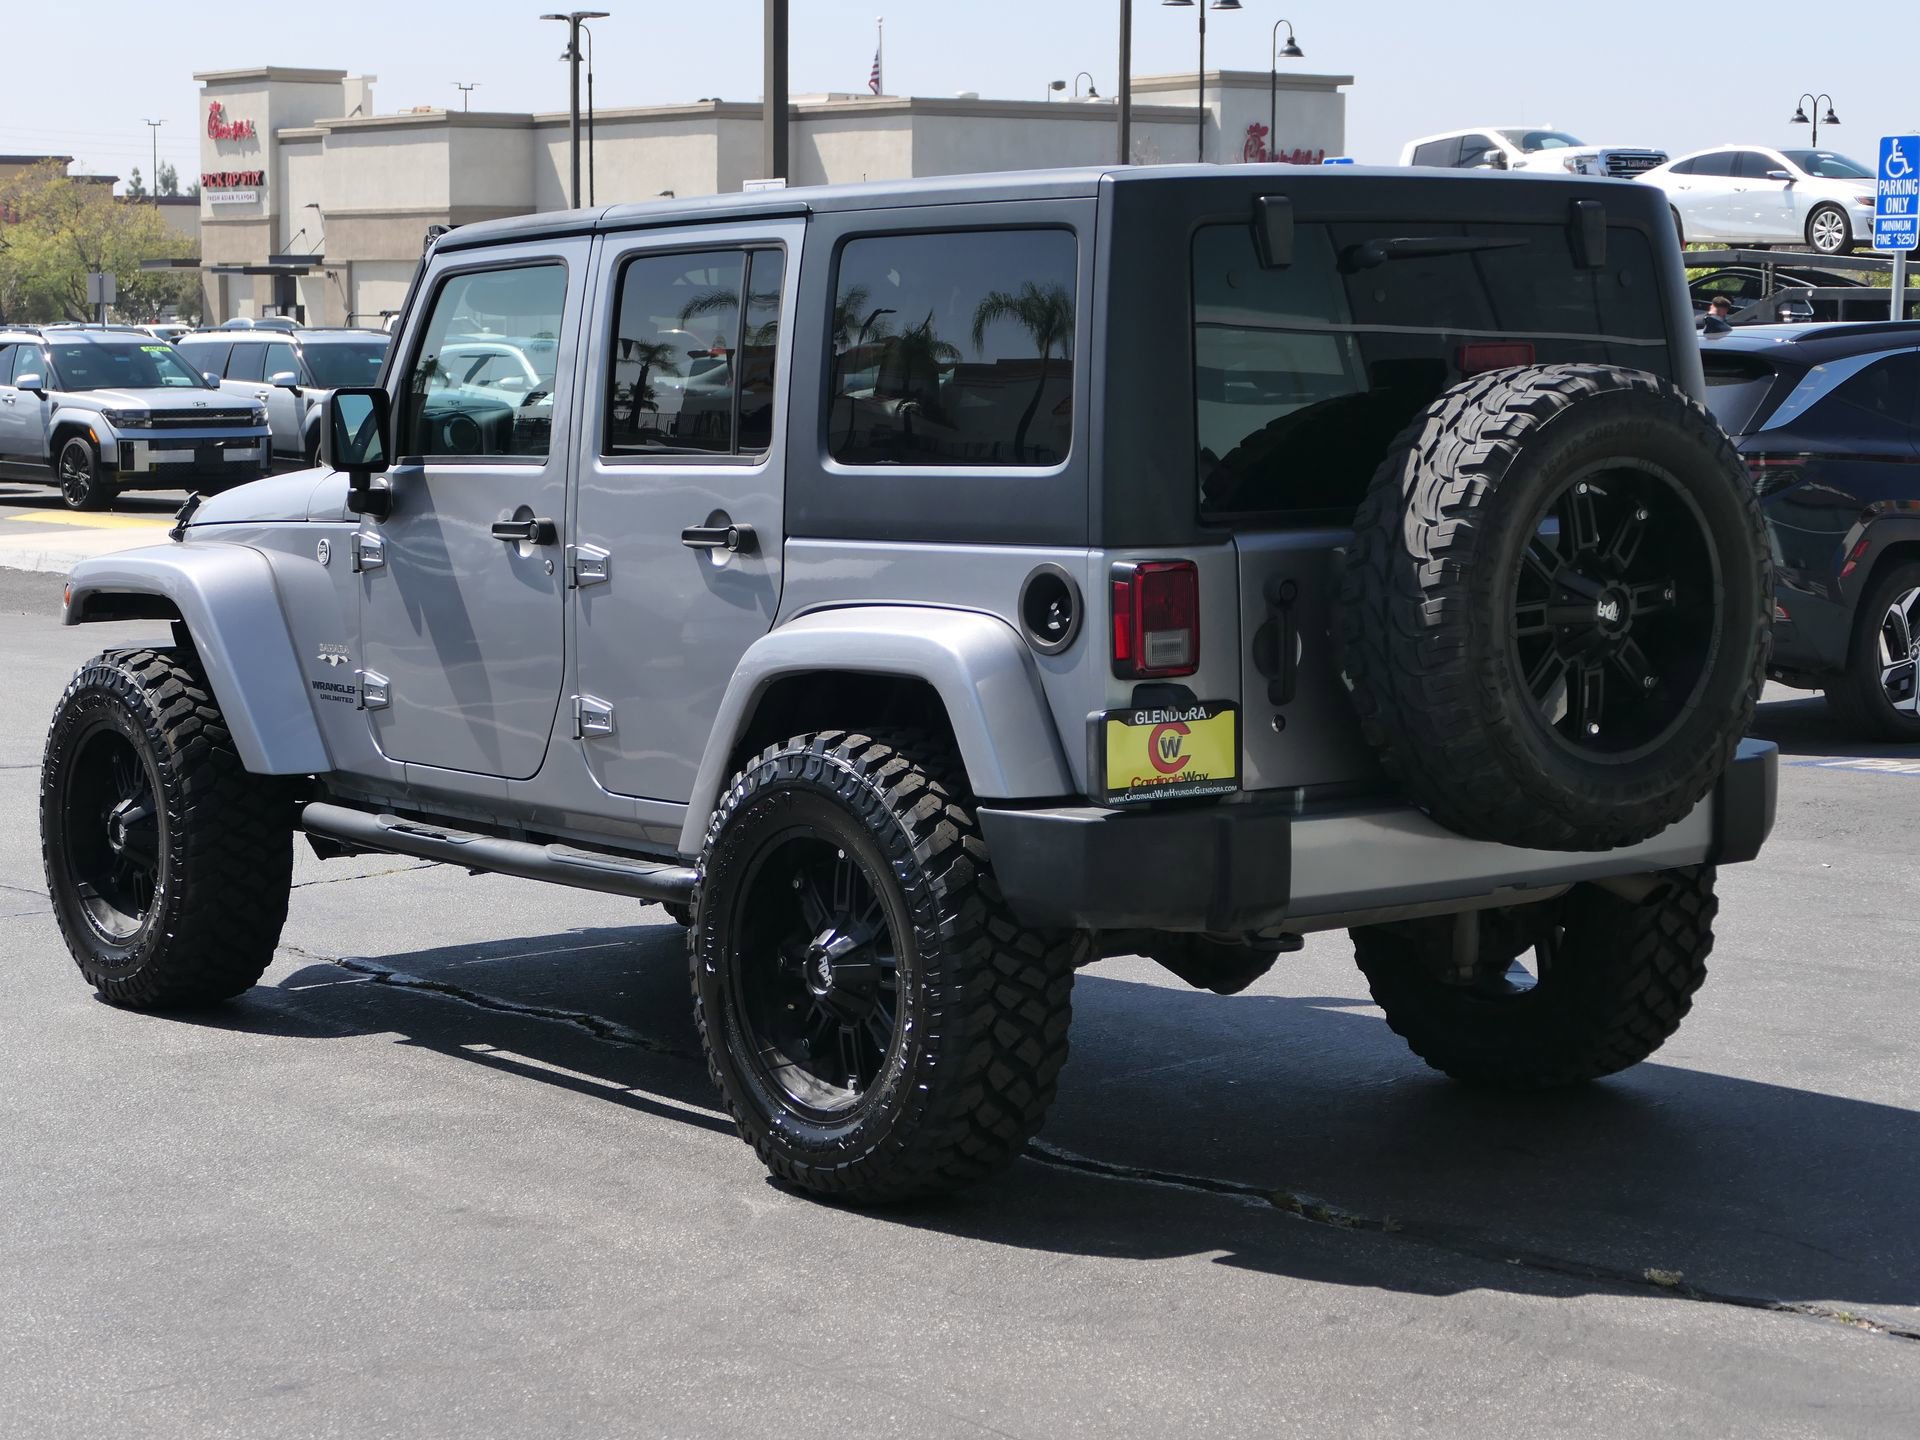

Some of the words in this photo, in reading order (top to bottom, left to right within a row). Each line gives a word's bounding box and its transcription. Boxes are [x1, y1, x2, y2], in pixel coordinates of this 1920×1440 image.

[201, 173, 224, 188] PICK
[225, 172, 240, 187] UP
[1879, 179, 1919, 196] PARKING
[1886, 197, 1910, 214] ONLY
[1881, 219, 1912, 232] MINIMUM
[1876, 234, 1892, 246] FINE
[1897, 233, 1915, 245] $250
[320, 693, 354, 704] UNLIMITED
[1135, 706, 1206, 724] GLENDORA
